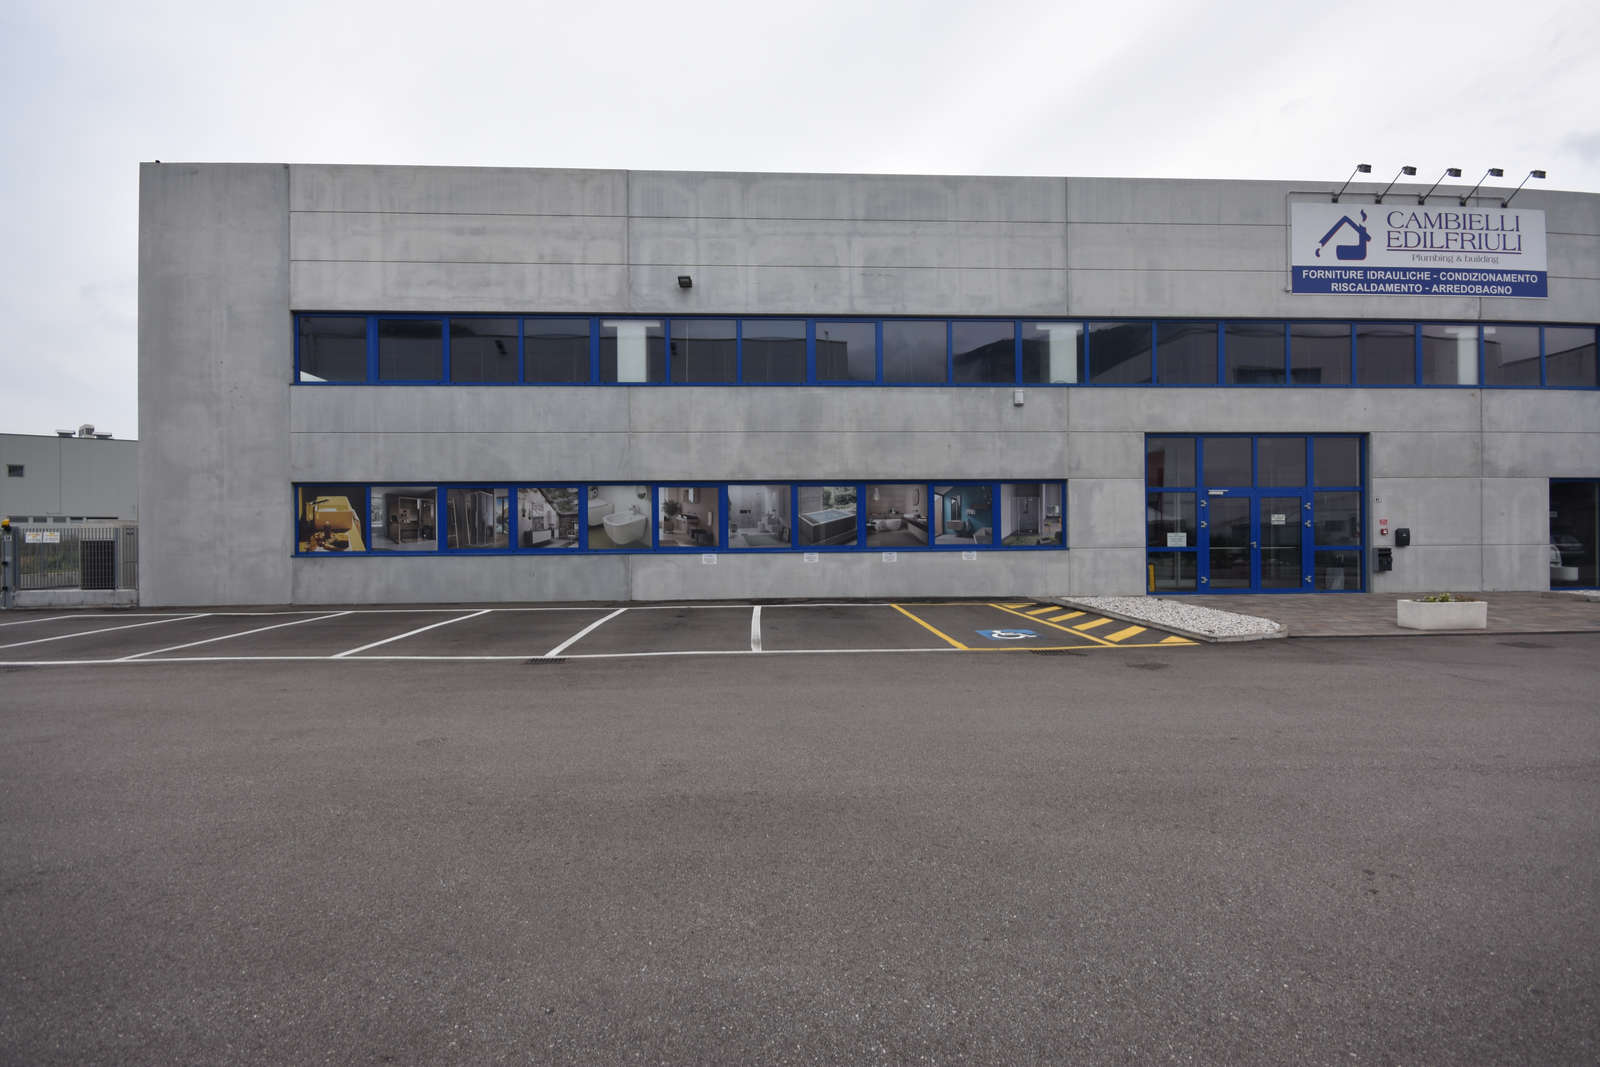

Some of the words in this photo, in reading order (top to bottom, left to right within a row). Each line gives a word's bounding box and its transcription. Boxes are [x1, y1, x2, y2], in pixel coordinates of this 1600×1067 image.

[1386, 210, 1521, 232] CAMBIELLI
[1386, 231, 1522, 252] EDILFRIULI
[1412, 253, 1454, 263] Plumbing
[1456, 254, 1463, 263] &
[1464, 254, 1500, 265] building
[1302, 269, 1364, 280] FORNITURE
[1367, 271, 1431, 281] IDRAULICHE
[1441, 271, 1538, 284] CONDIZIONAMENTO
[1330, 282, 1423, 293] RISCALDAMENTO
[1431, 284, 1513, 295] ARREDOBAGNO
